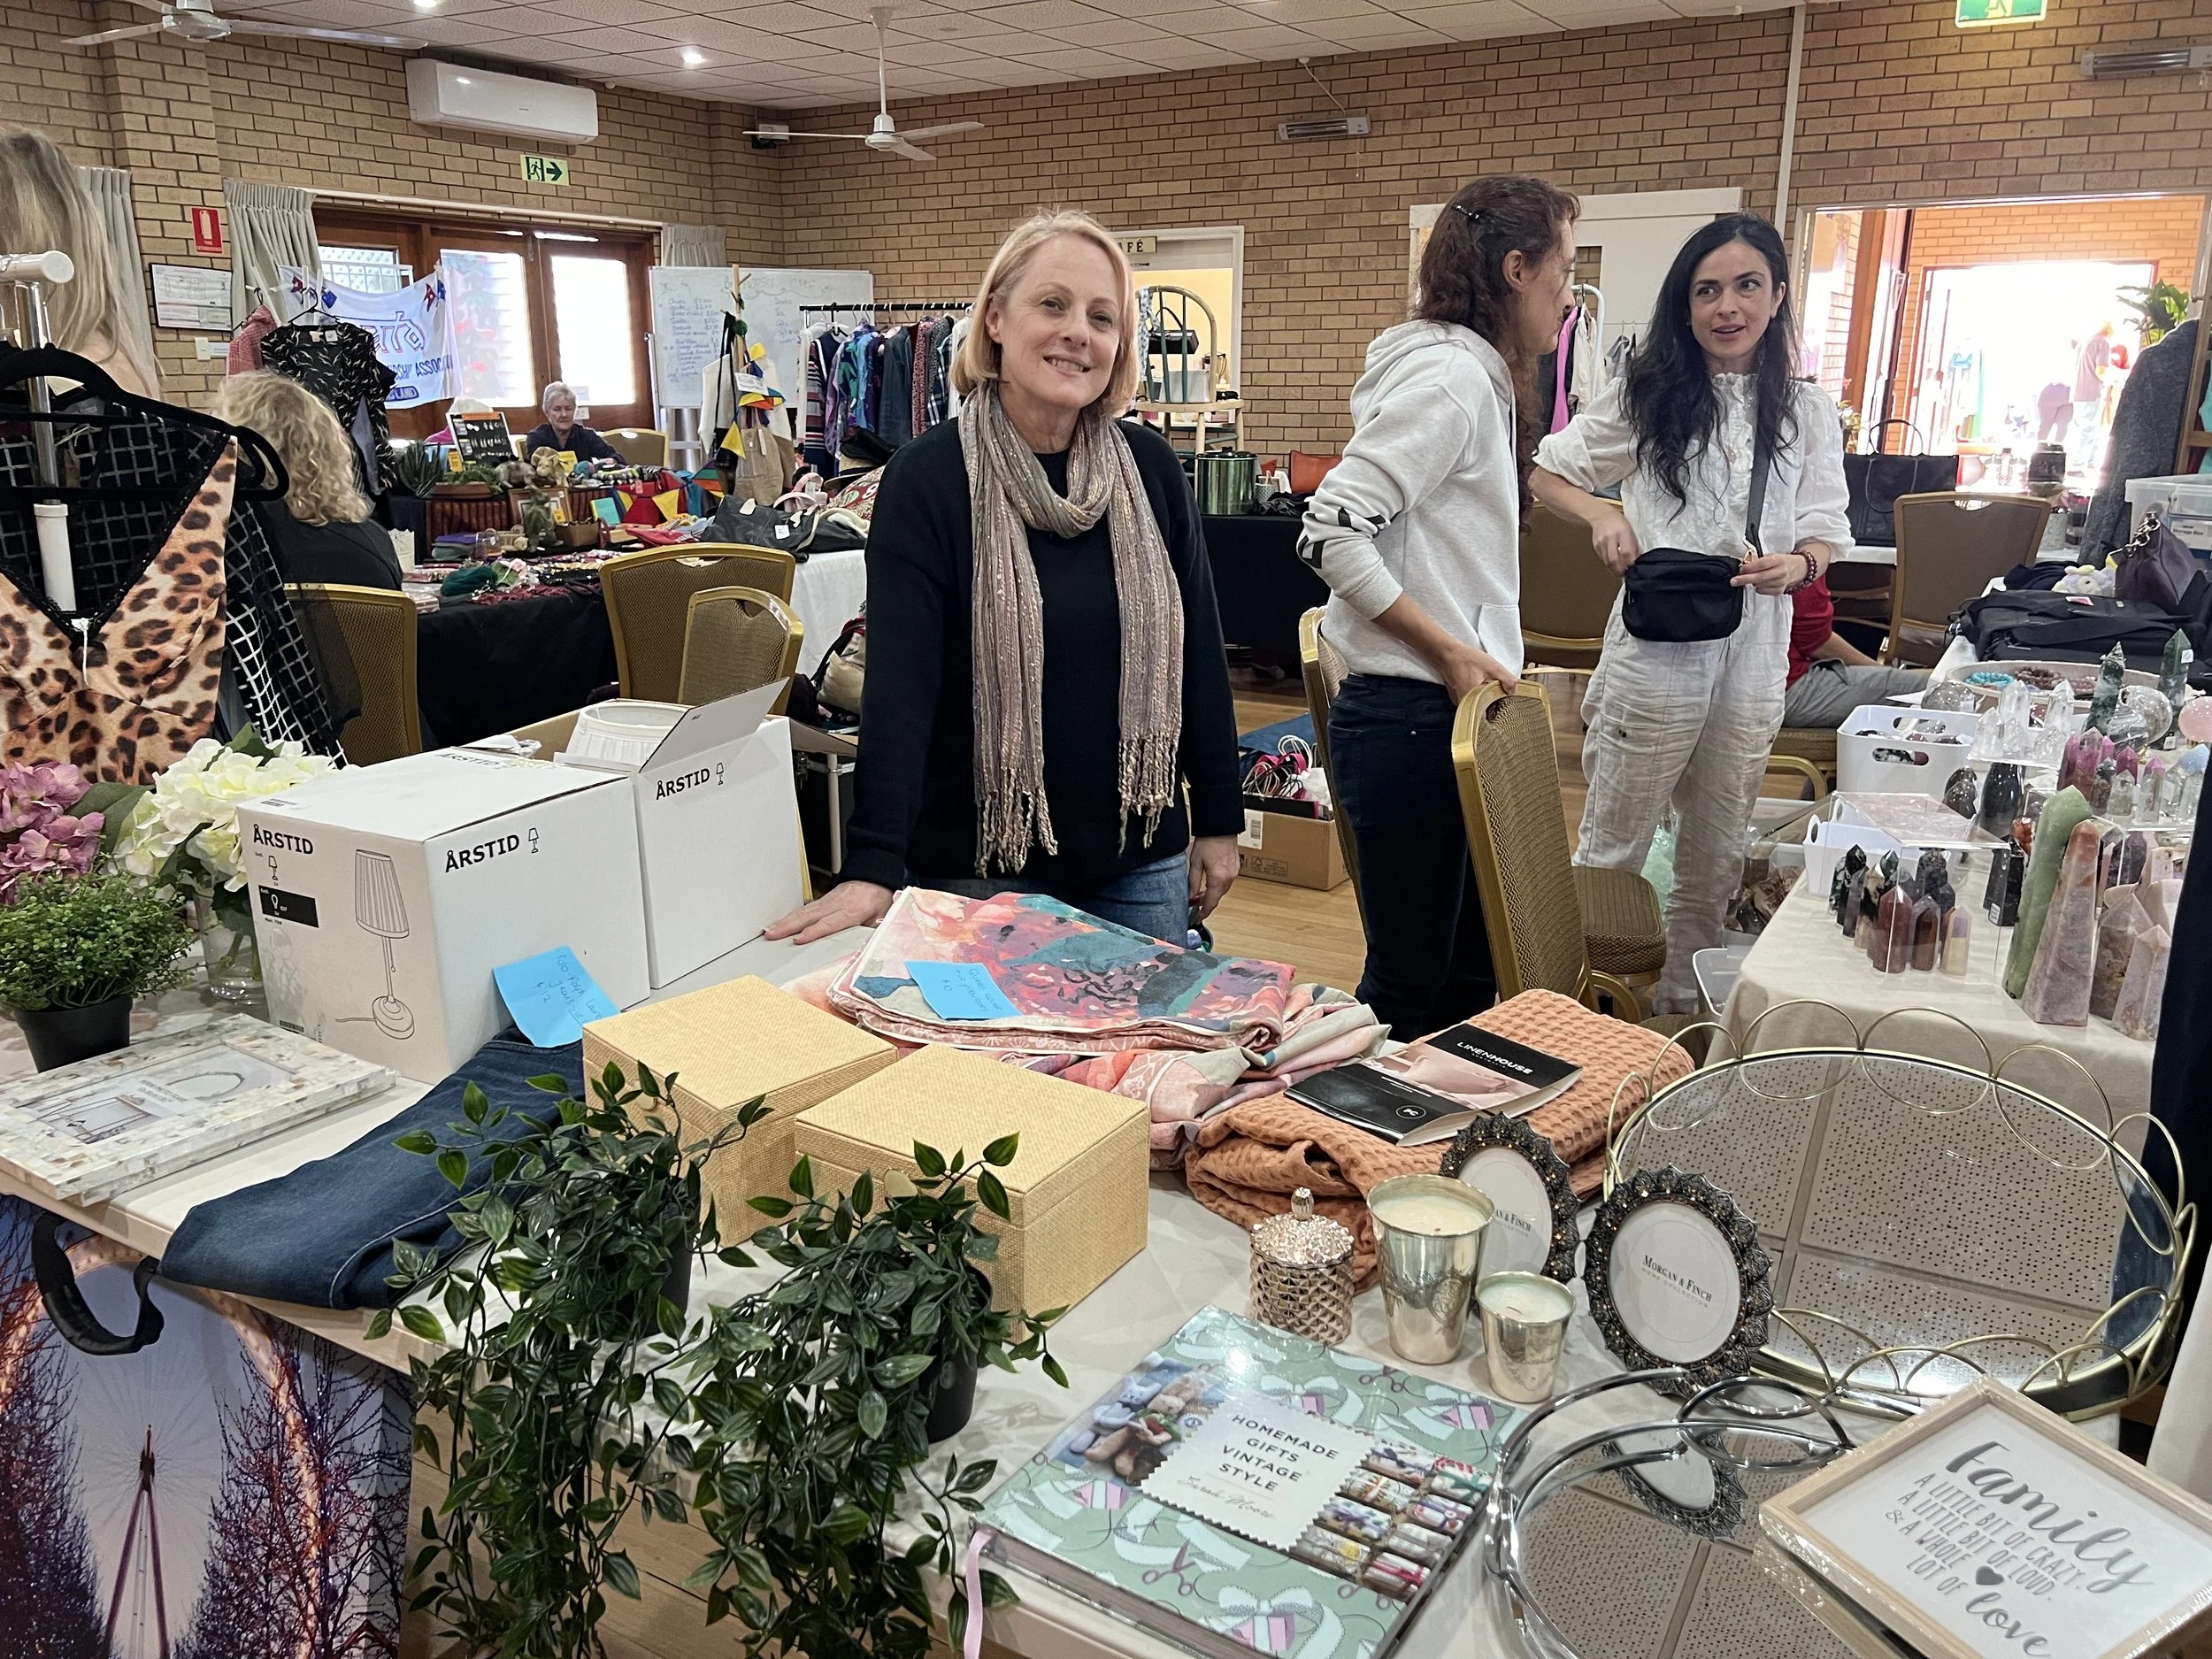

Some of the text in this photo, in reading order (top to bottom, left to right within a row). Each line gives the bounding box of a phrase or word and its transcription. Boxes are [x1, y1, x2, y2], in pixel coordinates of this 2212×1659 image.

[1118, 239, 1143, 253] AFÉ
[656, 767, 710, 800] ÅRSTID
[253, 823, 313, 855] ÅRSTID
[445, 833, 520, 872] ÅRSTID
[1456, 1041, 1533, 1075] LINENHOUSE
[1511, 1213, 1531, 1232] FINCH
[1642, 1254, 1678, 1281] MORGAN
[1686, 1279, 1712, 1302] FINCH
[1233, 1414, 1339, 1460] HOMEMADE
[1247, 1438, 1300, 1463] GIFTS
[1219, 1463, 1279, 1491] STYLE
[1223, 1445, 1302, 1483] VINTAGE
[1897, 1489, 1919, 1505] A
[1912, 1498, 1969, 1537] LITTLE
[1958, 1529, 1996, 1555] BIT
[1987, 1549, 2018, 1571] OF
[1915, 1472, 1936, 1488] A
[1929, 1480, 1985, 1518] LITTLE
[1975, 1511, 2012, 1536] BIT
[2003, 1531, 2035, 1552] OF
[1946, 1441, 2154, 1594] Family
[1885, 1509, 1974, 1570] & A WHOLE
[1906, 1553, 1968, 1595] LOT OF
[1965, 1592, 2052, 1657] love
